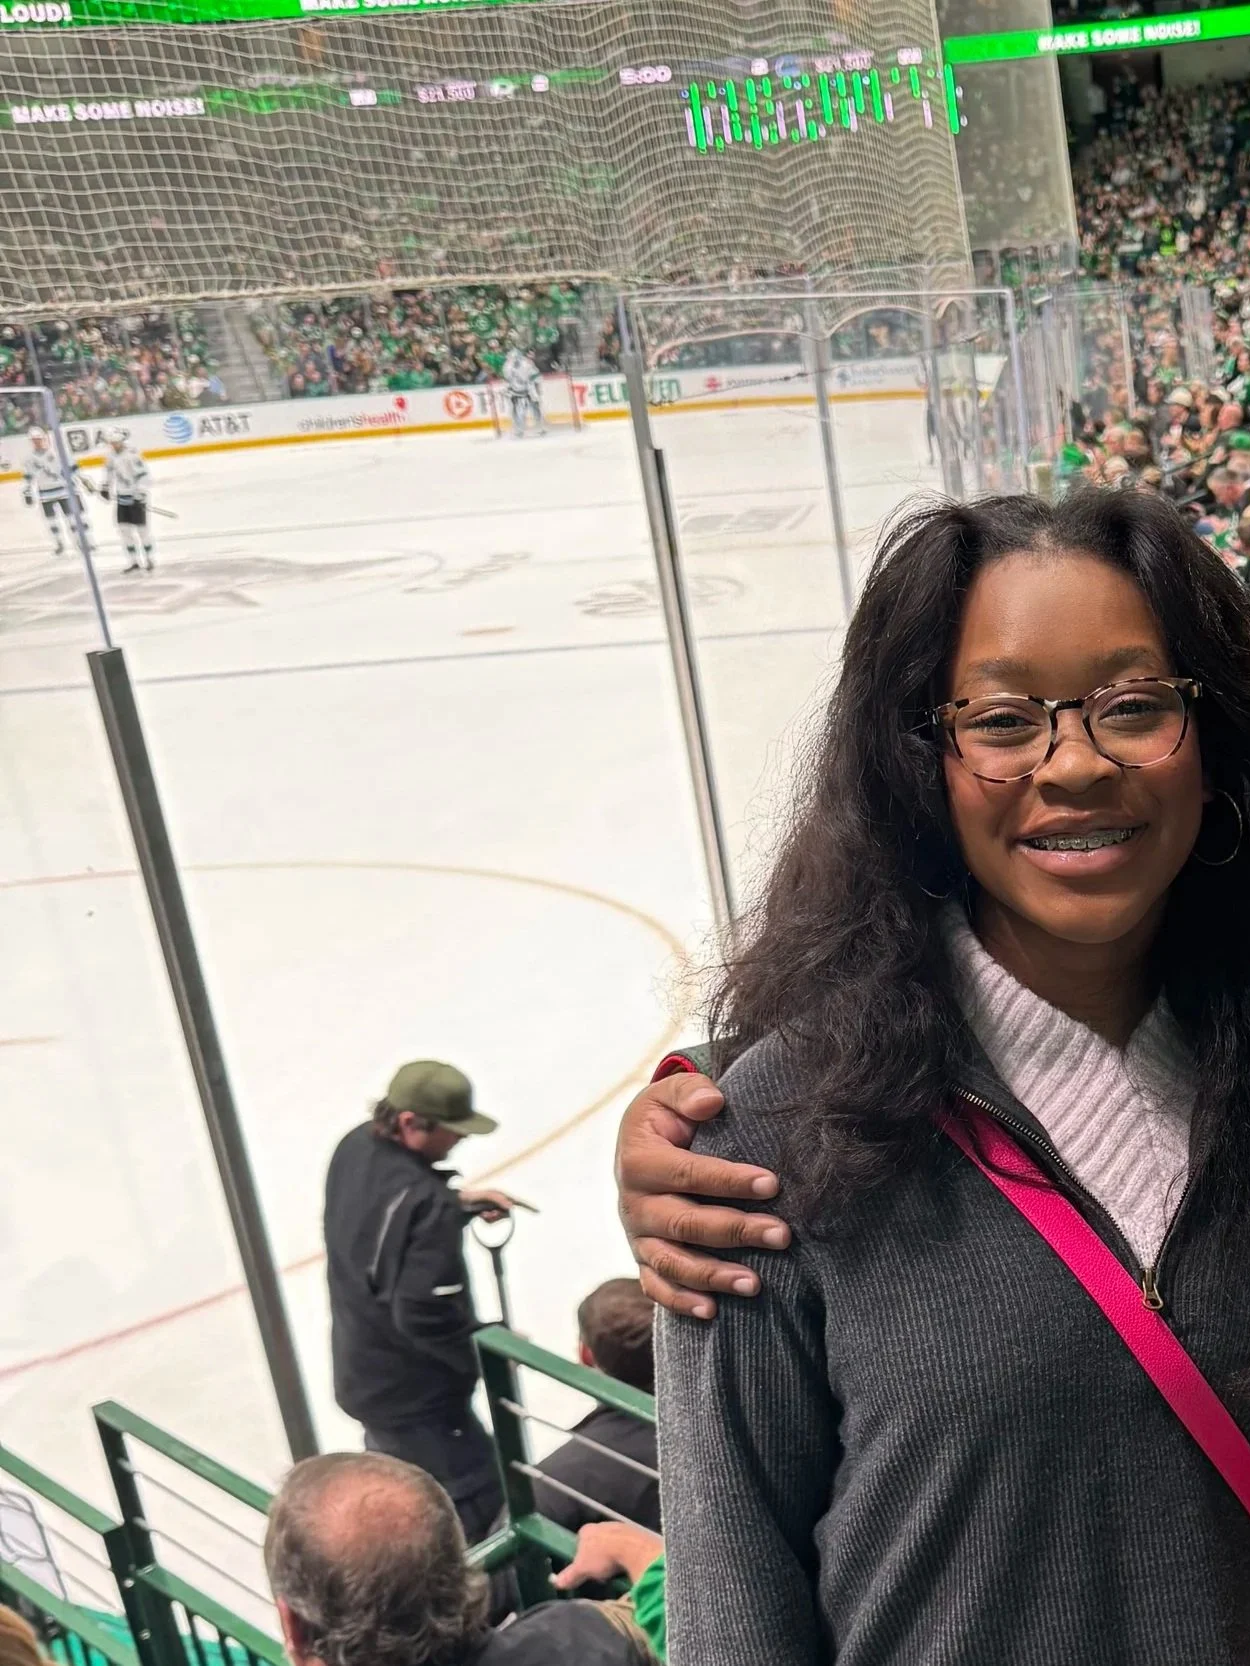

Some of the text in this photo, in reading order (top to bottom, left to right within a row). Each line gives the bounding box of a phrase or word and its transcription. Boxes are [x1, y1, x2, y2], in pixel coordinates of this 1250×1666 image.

[0, 3, 72, 23] LOUD!
[1038, 19, 1201, 51] MAKE SOME NOISE!
[619, 65, 672, 85] 5:00
[11, 98, 205, 123] MAKE SOME NOISE!
[199, 412, 252, 438] AT&T
